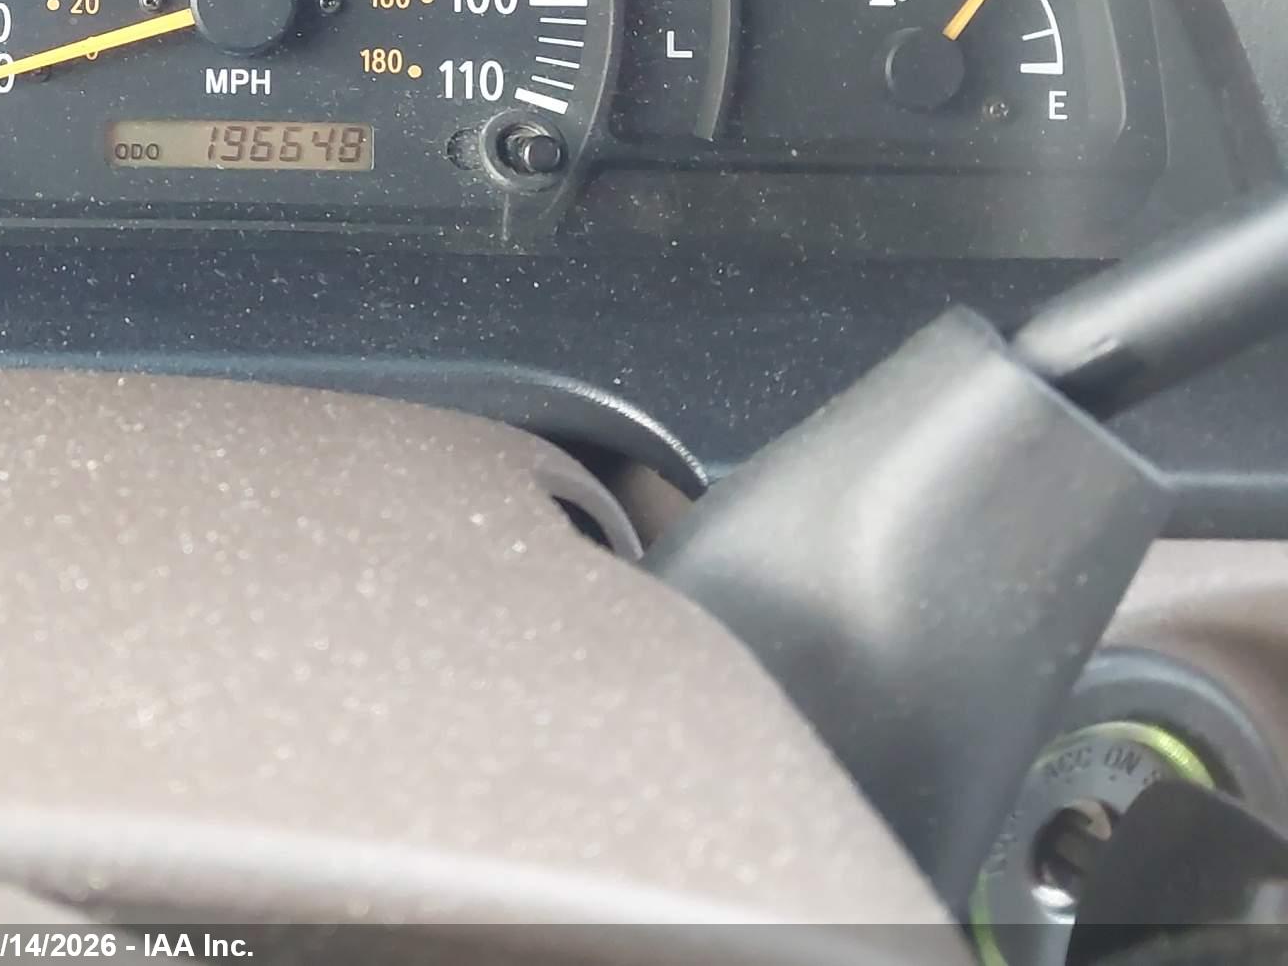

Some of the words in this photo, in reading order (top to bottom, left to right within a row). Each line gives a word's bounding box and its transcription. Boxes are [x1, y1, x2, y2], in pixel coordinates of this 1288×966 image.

[667, 31, 692, 58] L
[360, 49, 402, 73] 180
[206, 69, 270, 94] MPH
[439, 61, 503, 101] 110
[1049, 91, 1067, 119] E
[114, 143, 160, 161] ODO
[208, 126, 365, 162] 196648
[1103, 745, 1142, 776] ON
